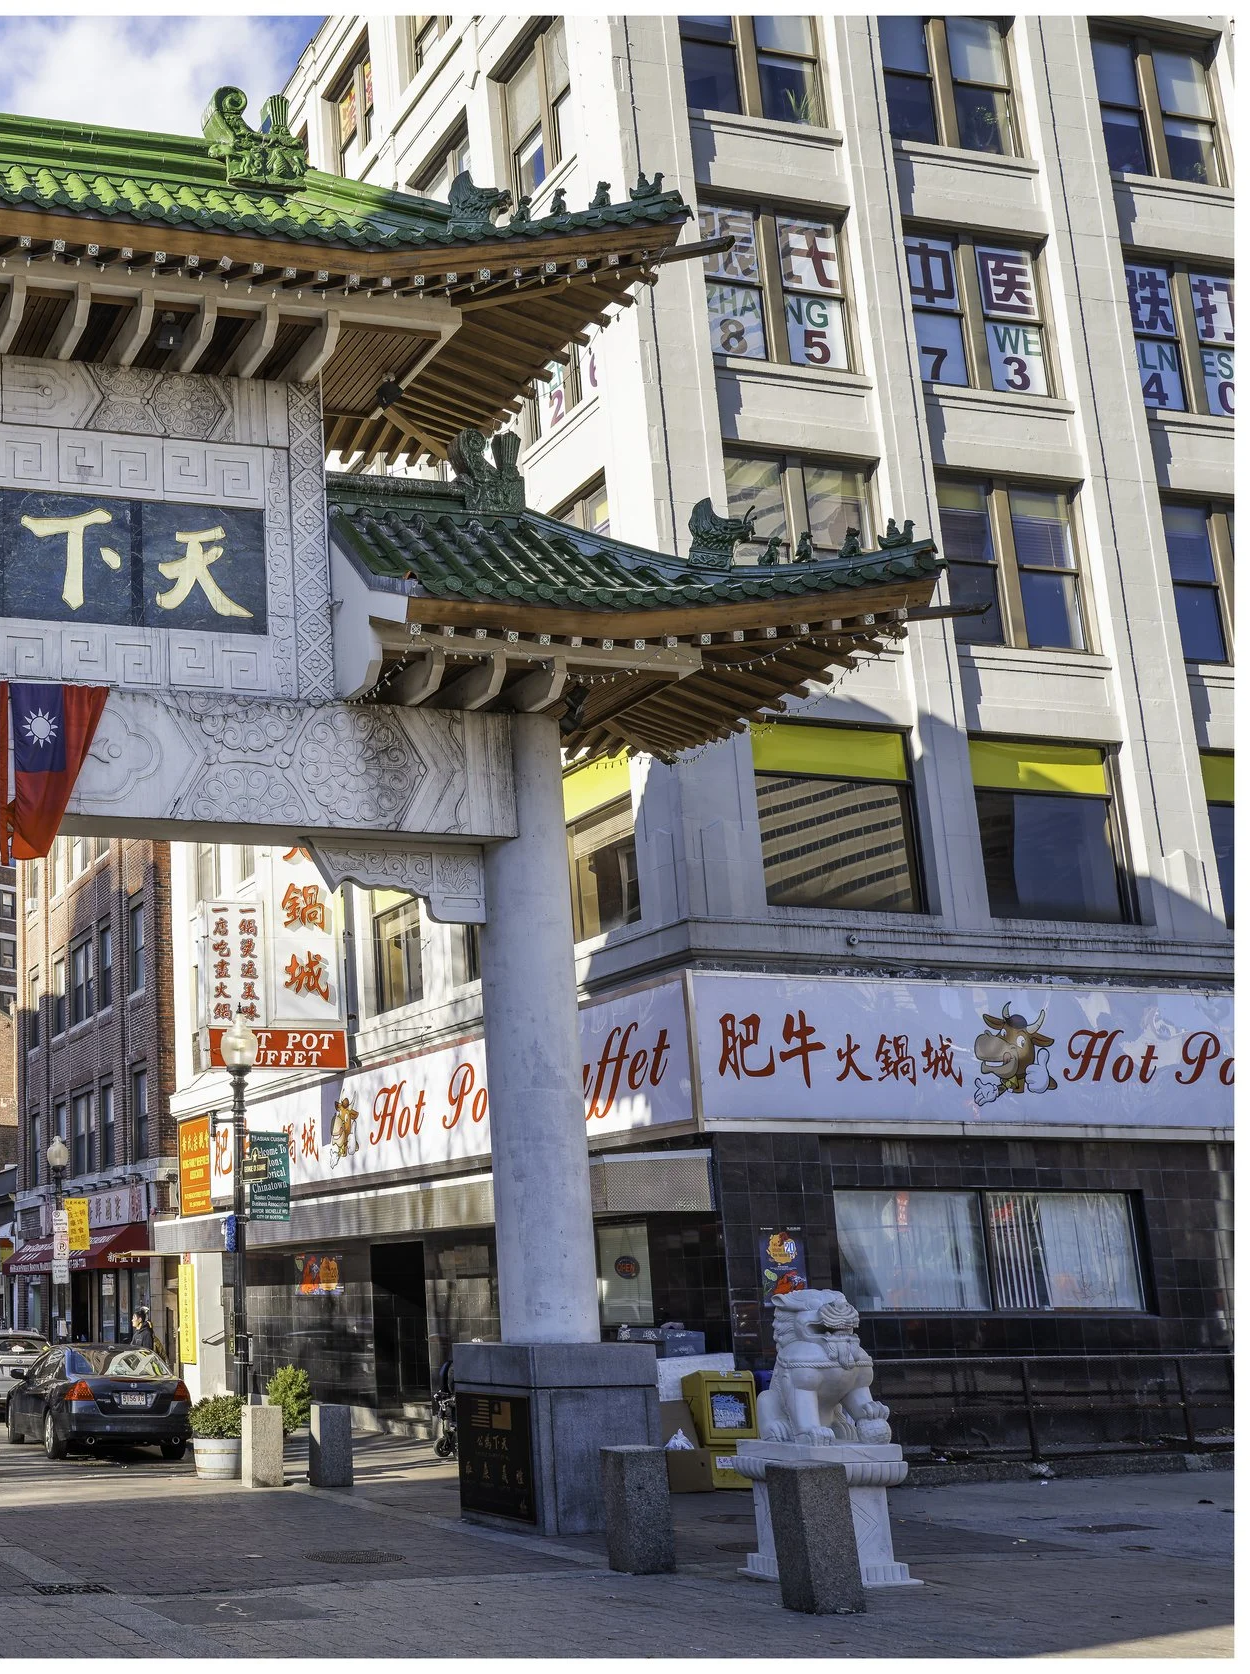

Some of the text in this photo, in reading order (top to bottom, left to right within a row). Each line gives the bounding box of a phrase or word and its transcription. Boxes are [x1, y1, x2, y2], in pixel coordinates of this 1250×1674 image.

[287, 1032, 335, 1050] POT
[718, 1009, 964, 1089] 肥牛火鍋城
[255, 1051, 322, 1067] UFFET
[1063, 1028, 1158, 1085] Hot
[369, 1021, 671, 1146] Hot Po ffet
[258, 1147, 278, 1157] elcome
[252, 1180, 287, 1194] Chinatown
